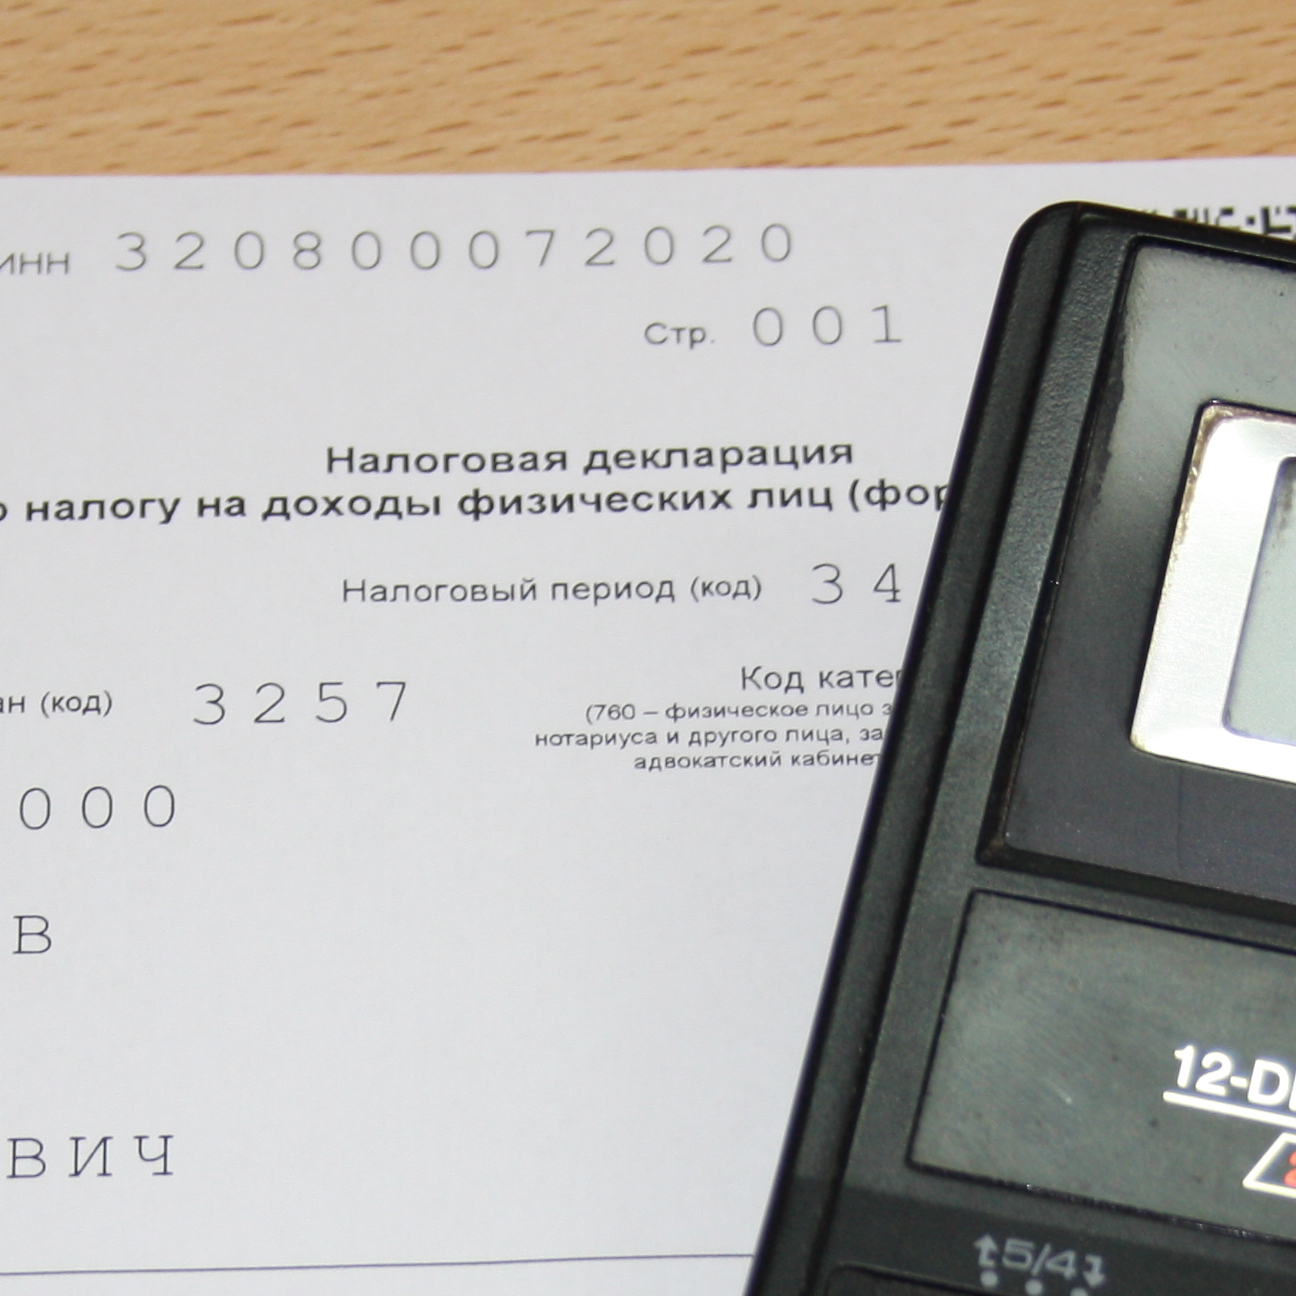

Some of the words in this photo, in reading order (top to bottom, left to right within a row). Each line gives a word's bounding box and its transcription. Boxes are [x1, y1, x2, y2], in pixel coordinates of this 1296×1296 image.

[115, 222, 793, 273] 320800072020
[643, 321, 715, 351] Стр.
[752, 304, 903, 348] 001
[327, 446, 568, 474] Налоговая
[582, 443, 853, 476] декларация
[25, 497, 181, 525] налогу
[197, 495, 247, 518] на
[261, 495, 441, 522] доходы
[457, 487, 733, 522] физических
[747, 486, 834, 512] лиц
[342, 577, 537, 603] Налоговый
[551, 579, 676, 607] период
[690, 574, 762, 603] (код)
[812, 562, 902, 605] 34
[741, 665, 805, 695] Код
[40, 690, 113, 719] (код)
[193, 681, 407, 726] 3257
[585, 703, 636, 725] (760
[664, 702, 809, 724] физическое
[815, 703, 874, 721] лицо
[535, 731, 658, 751] нотариуса
[666, 731, 679, 745] и
[687, 729, 778, 748] другого
[785, 728, 850, 747] лица,
[634, 750, 782, 773] адвокатский
